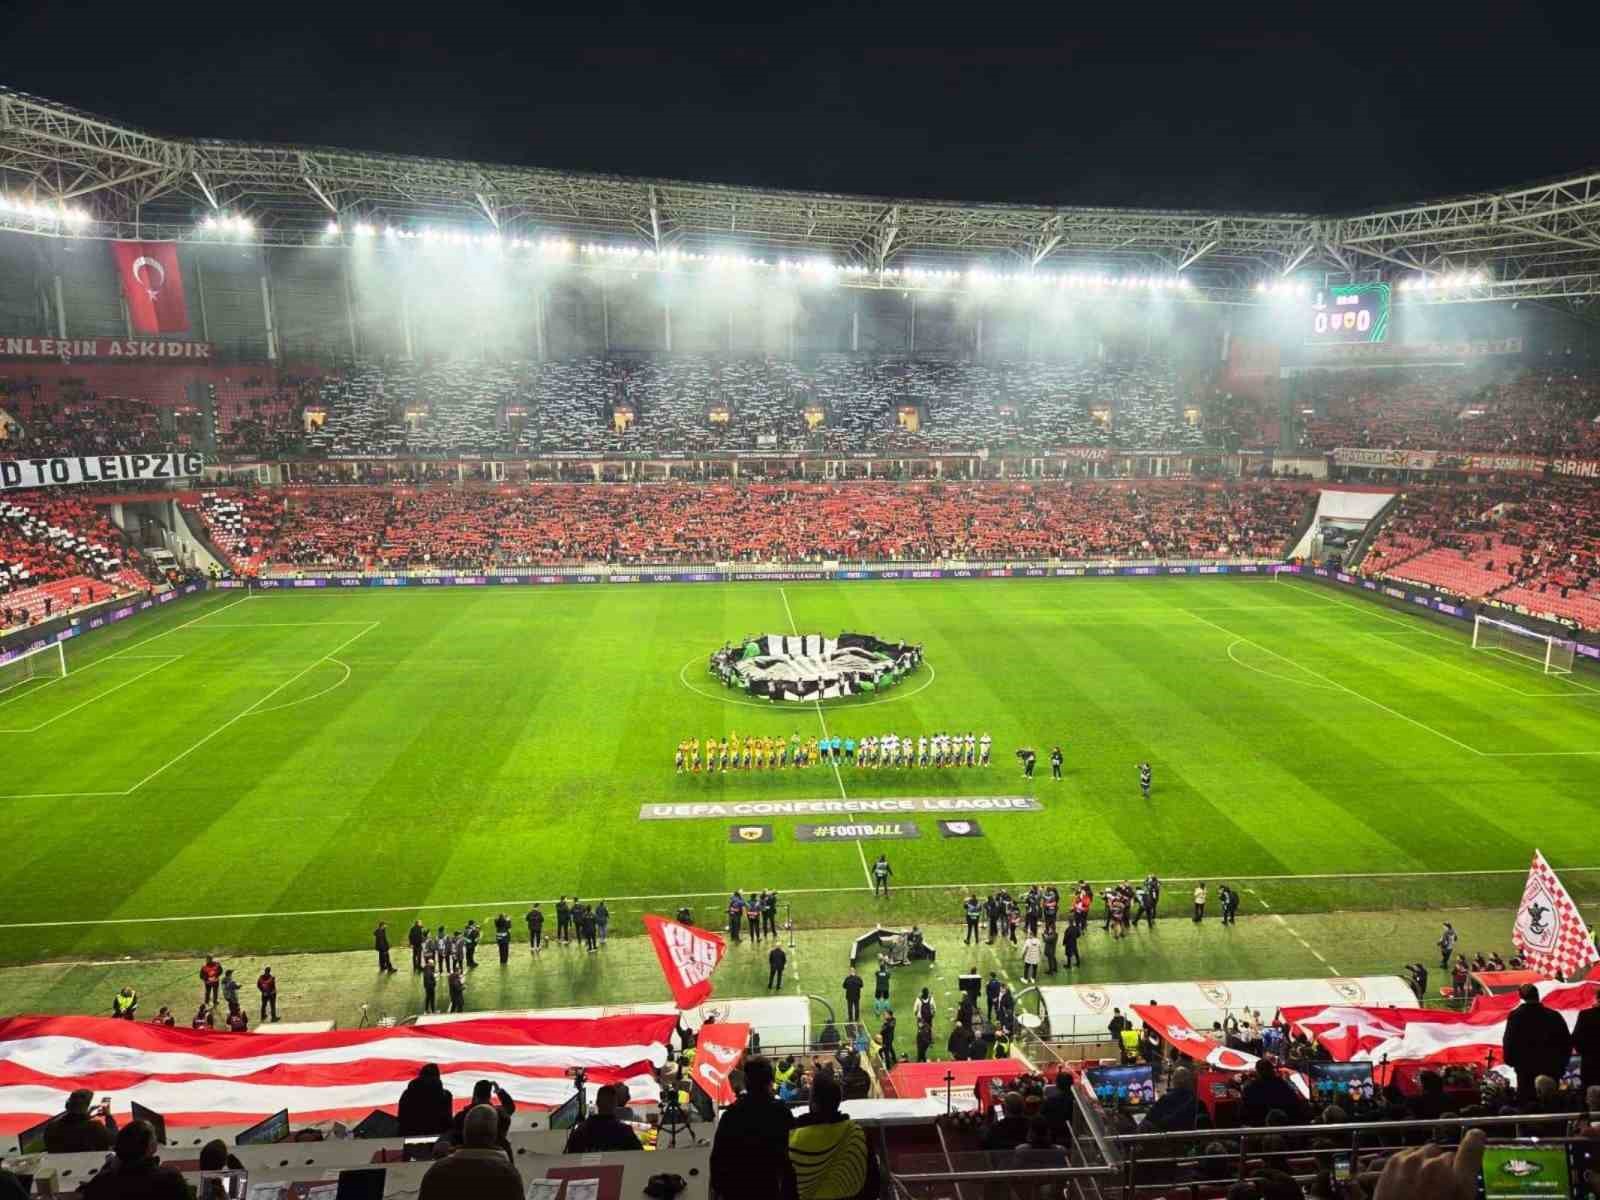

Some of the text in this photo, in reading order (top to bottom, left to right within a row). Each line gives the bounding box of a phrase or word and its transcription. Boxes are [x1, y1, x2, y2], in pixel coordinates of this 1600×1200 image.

[30, 459, 69, 484] TO
[79, 453, 202, 482] LEIPZIG
[653, 797, 1031, 816] UEFA CONFERENCE LEAGUE
[813, 823, 903, 837] #FOOTBALL
